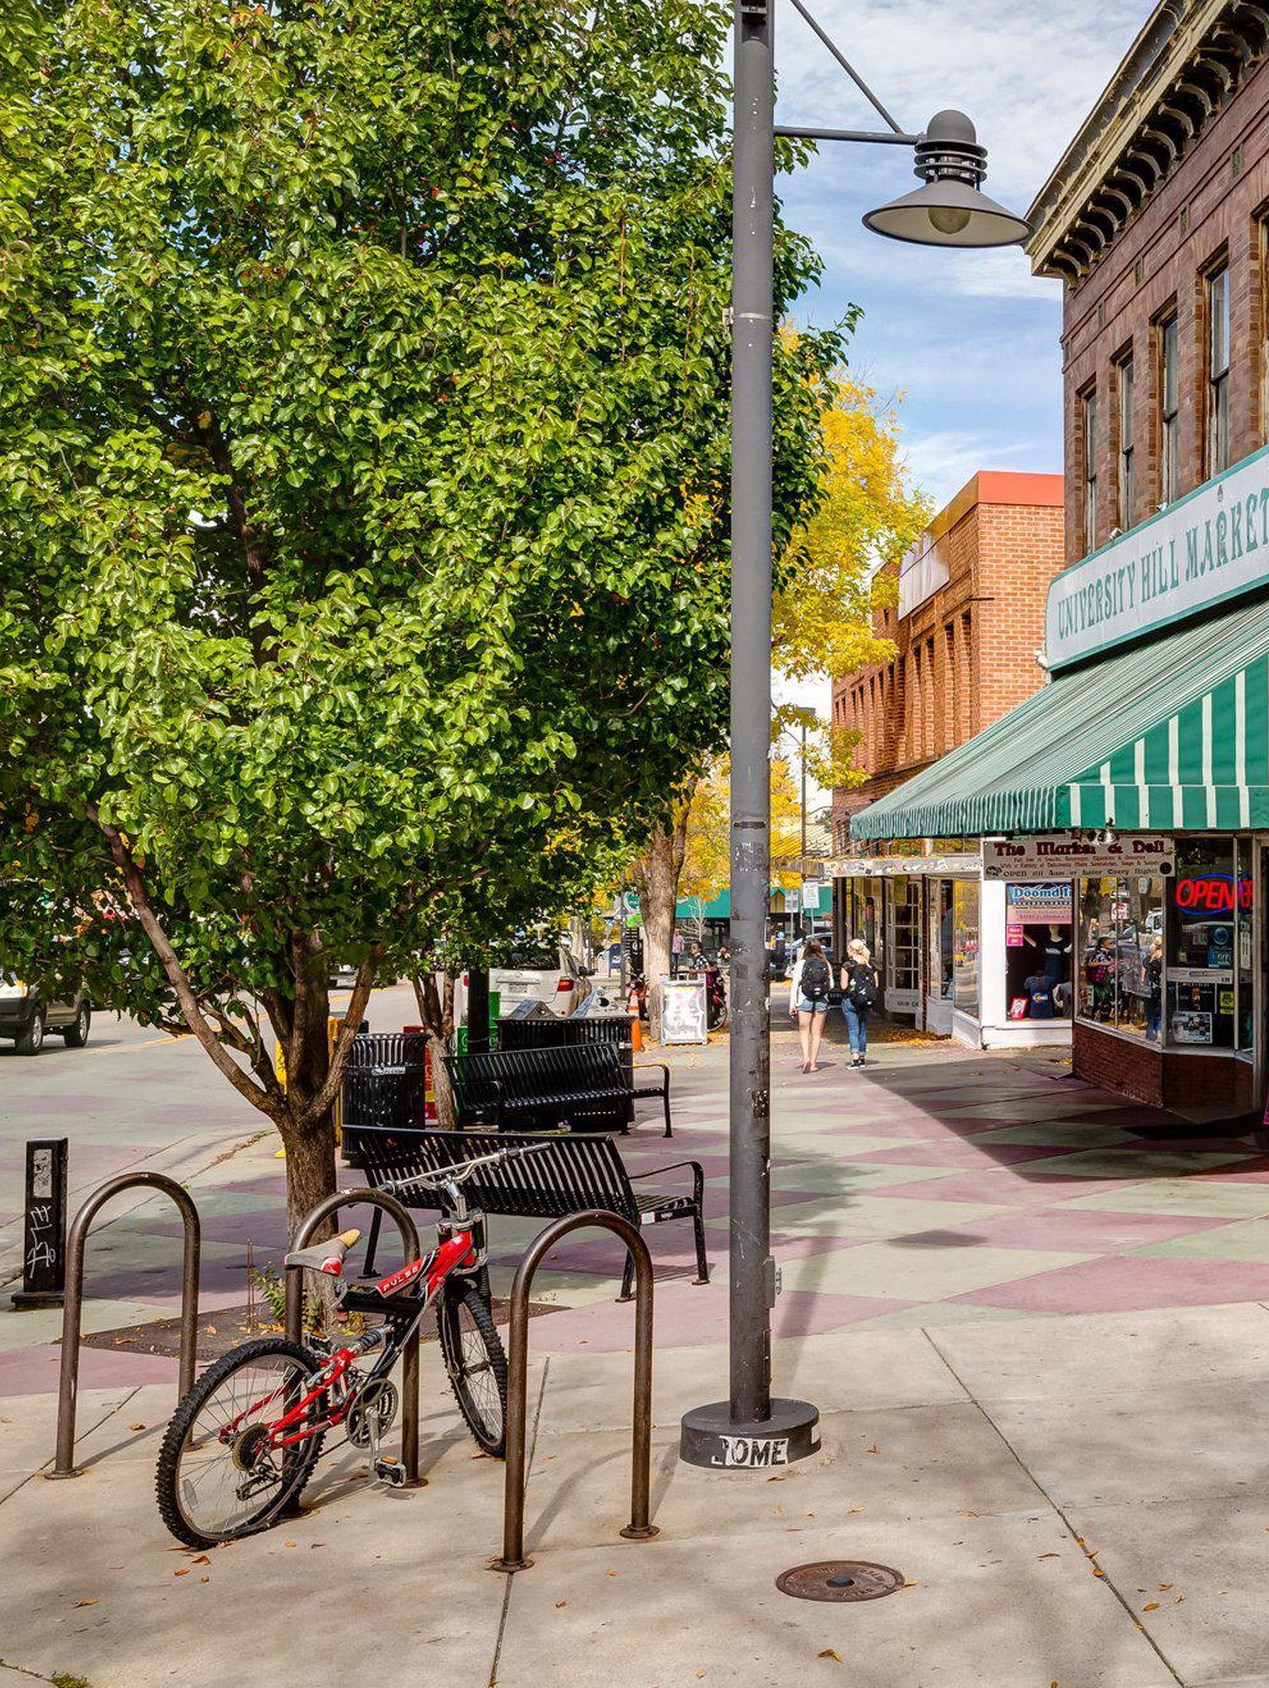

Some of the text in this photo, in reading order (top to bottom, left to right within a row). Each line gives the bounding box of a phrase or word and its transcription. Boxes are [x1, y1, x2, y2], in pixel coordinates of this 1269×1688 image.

[1057, 560, 1136, 639] UNIVERSITY
[1141, 539, 1179, 603] HILL
[994, 842, 1026, 857] The
[1176, 879, 1235, 910] OPEN
